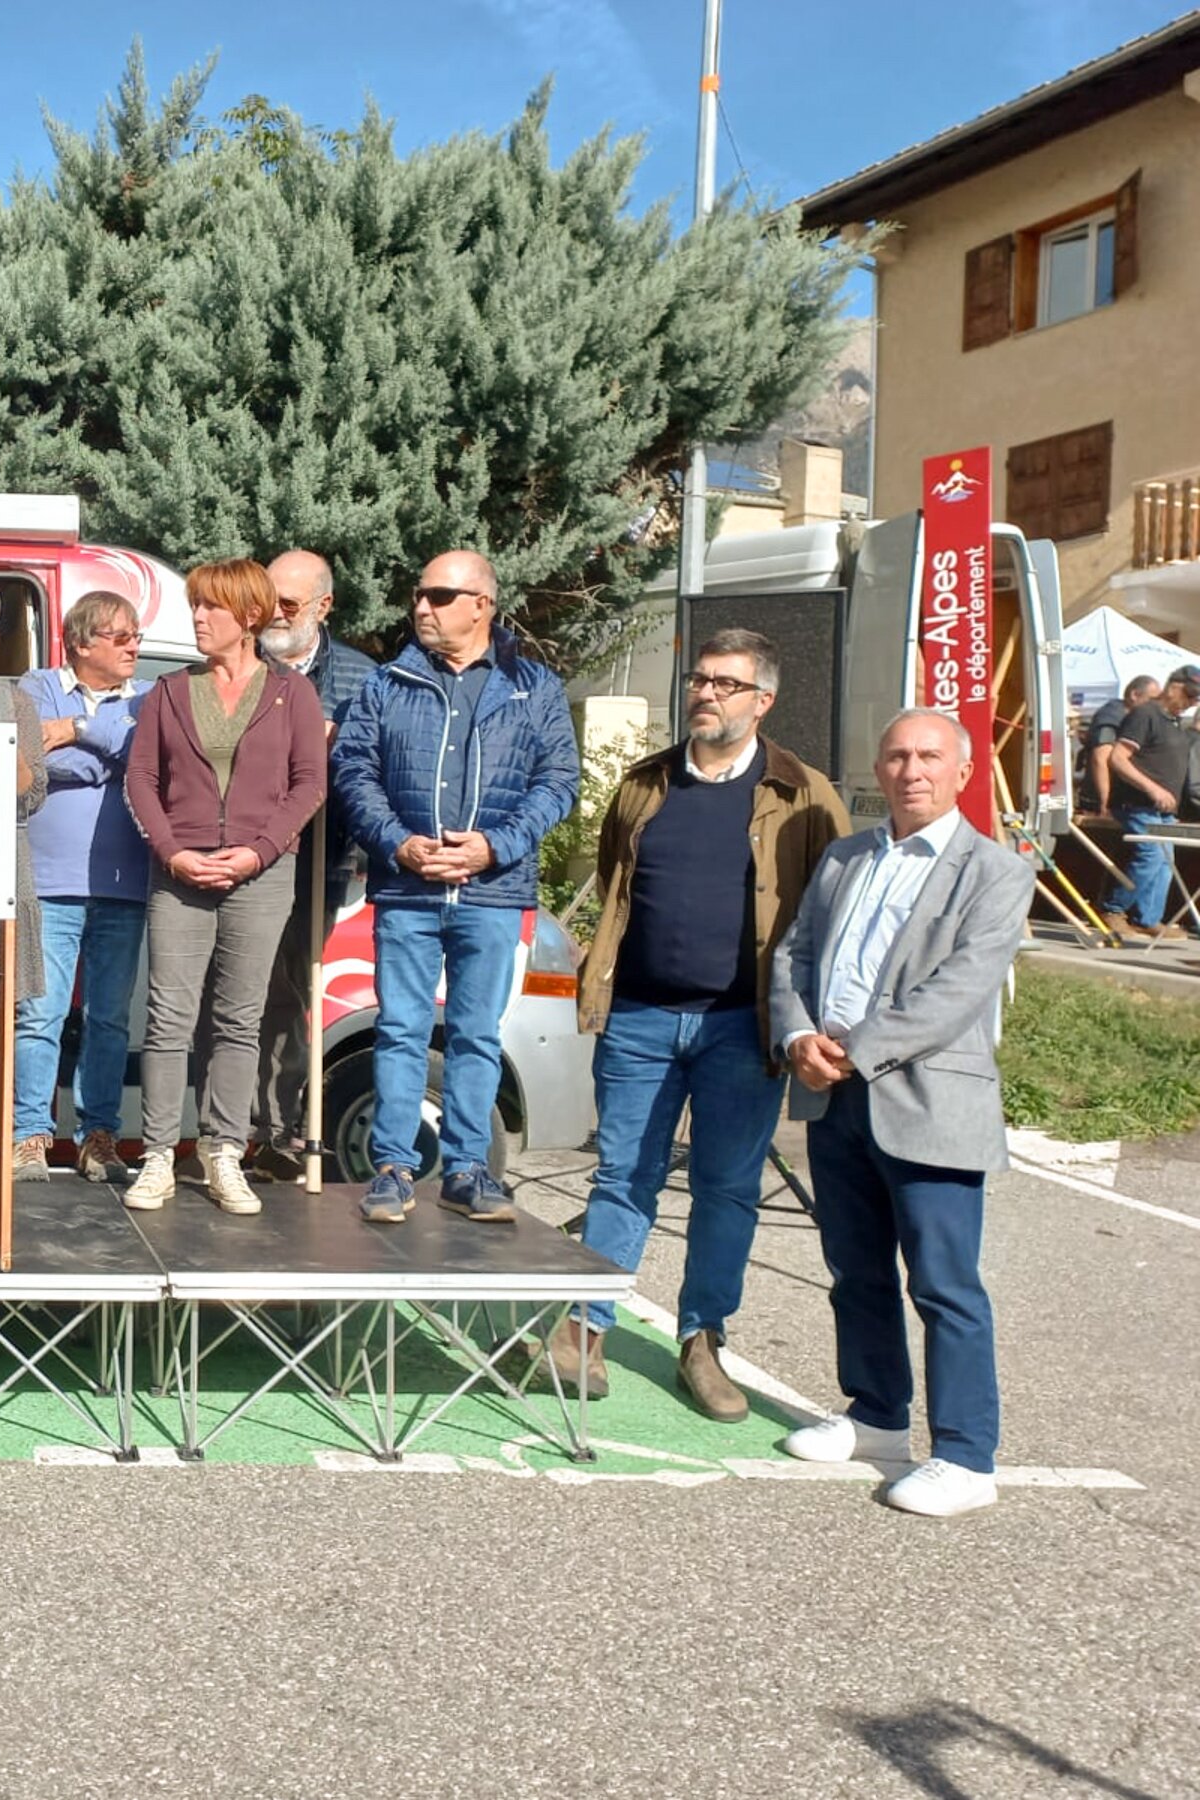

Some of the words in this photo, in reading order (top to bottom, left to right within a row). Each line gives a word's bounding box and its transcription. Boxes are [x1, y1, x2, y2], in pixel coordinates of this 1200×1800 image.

[924, 549, 968, 723] tes-Alpes
[964, 545, 991, 680] département
[966, 684, 987, 702] le
